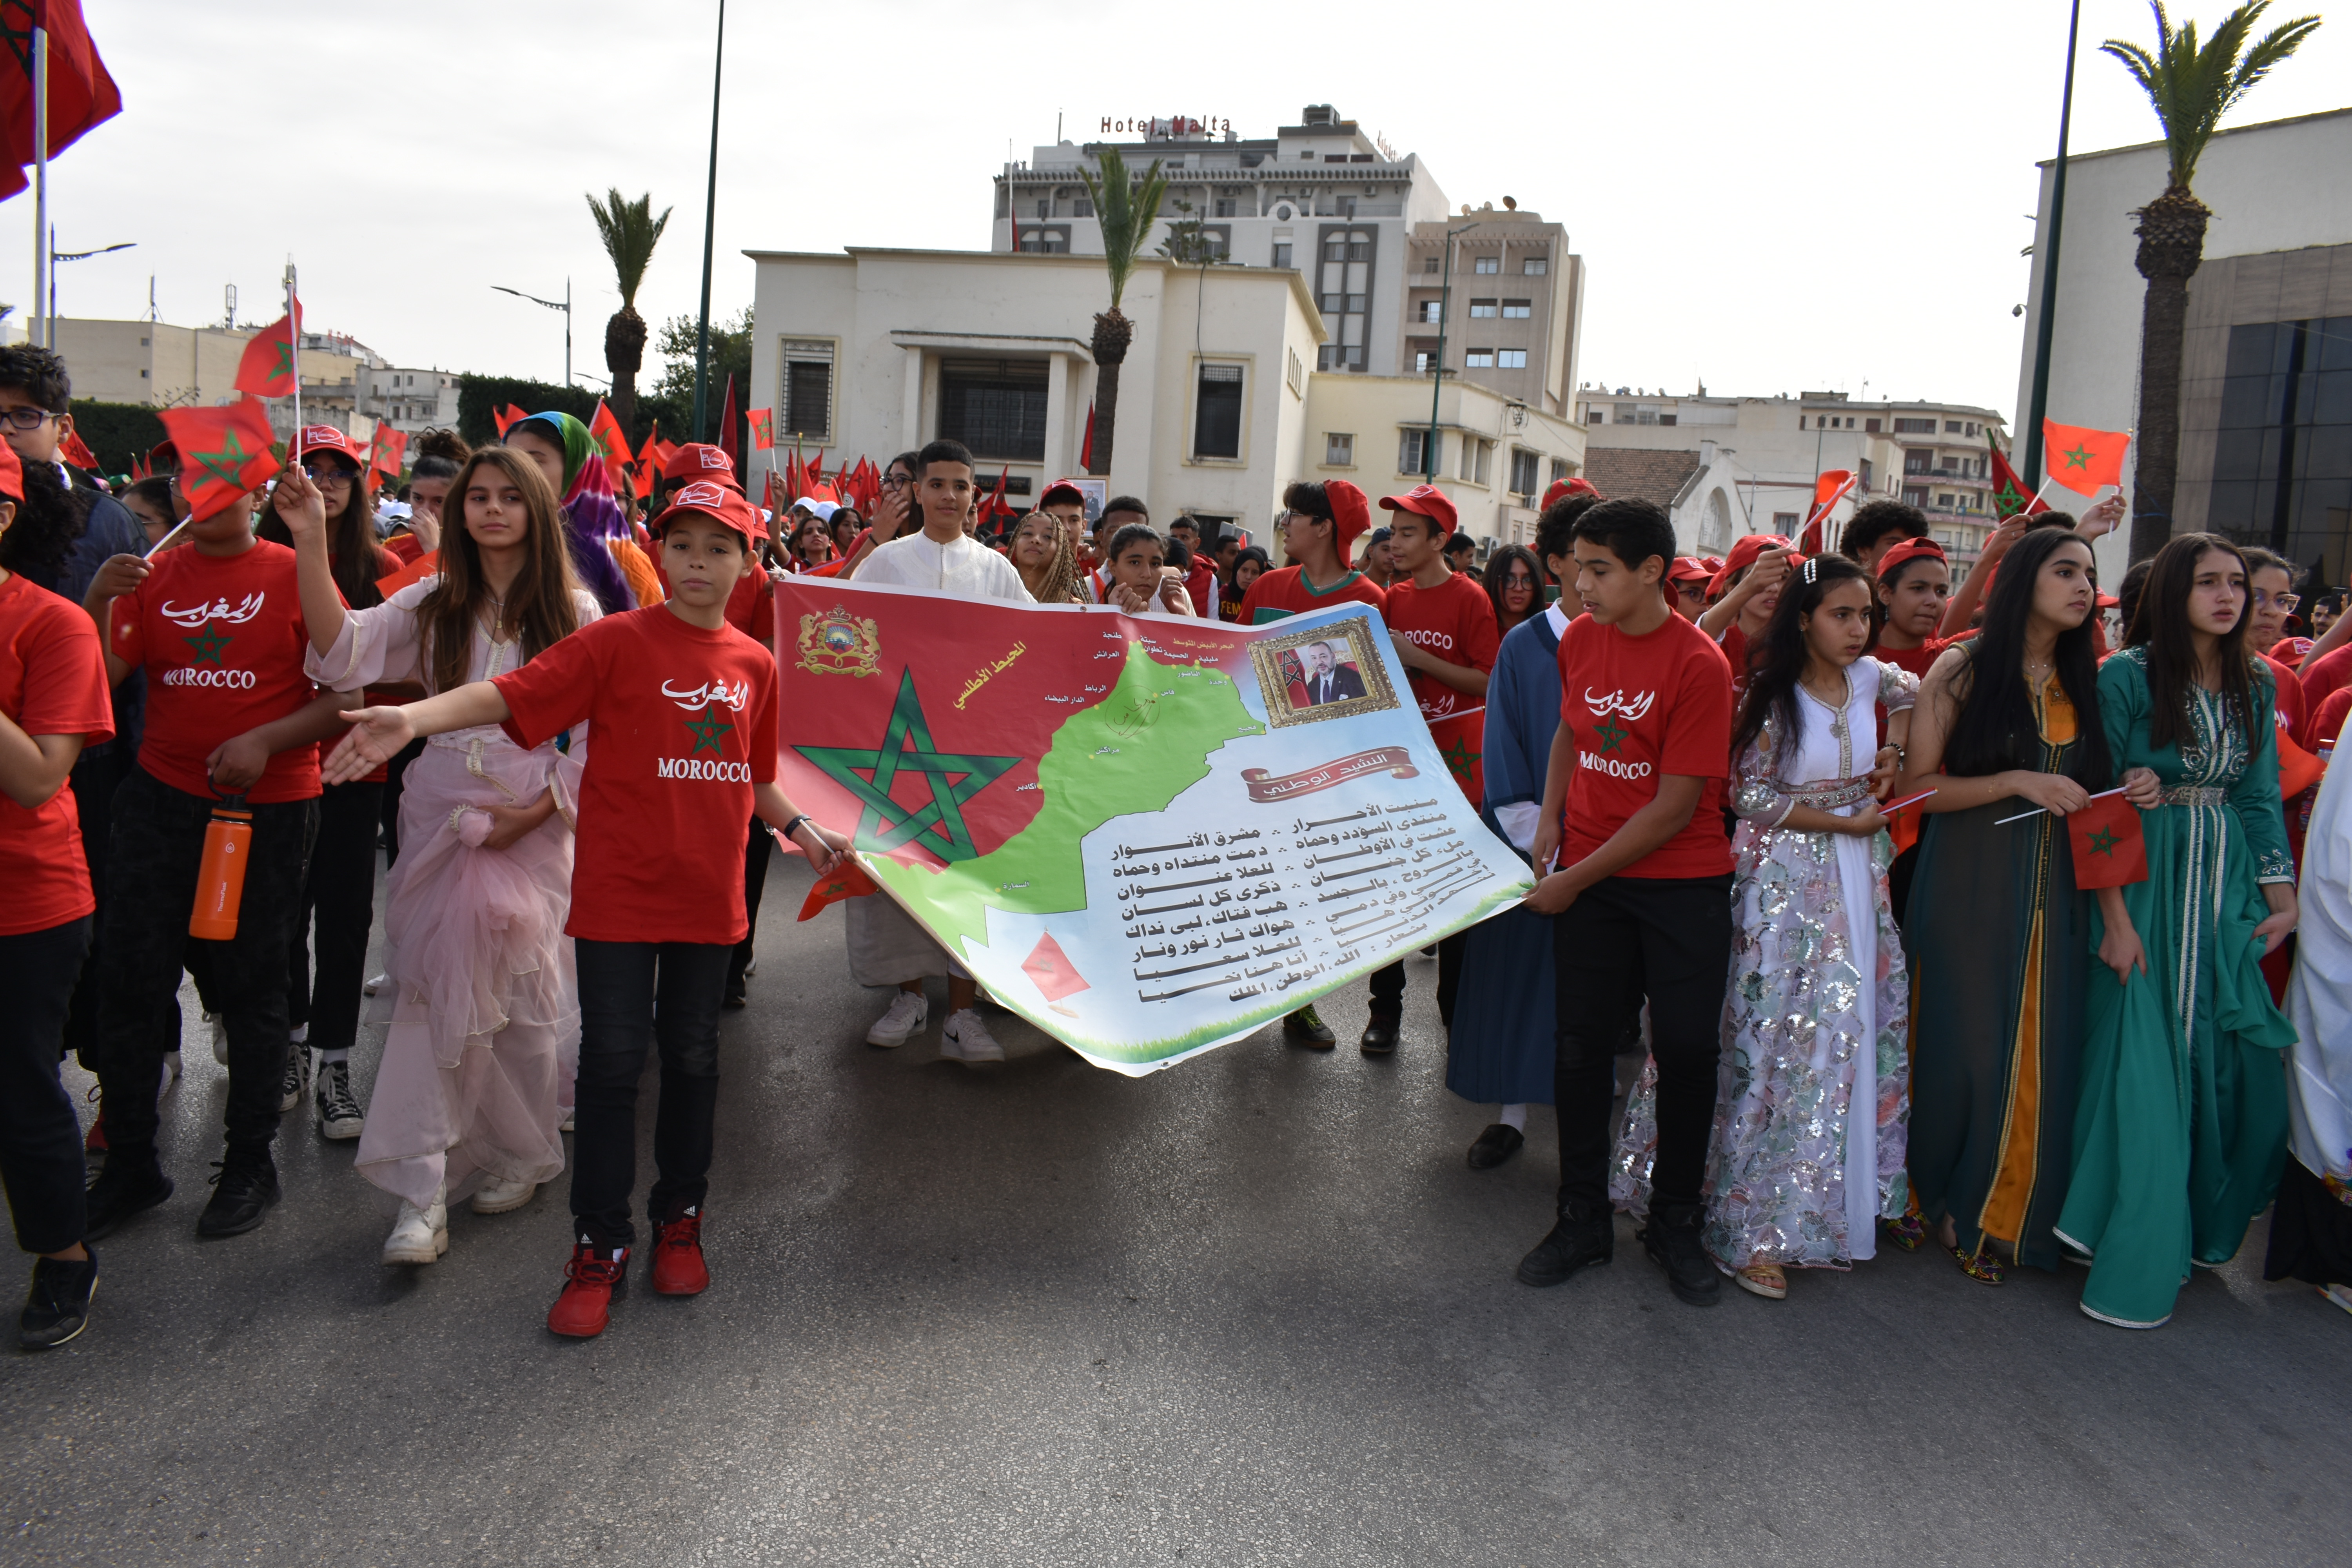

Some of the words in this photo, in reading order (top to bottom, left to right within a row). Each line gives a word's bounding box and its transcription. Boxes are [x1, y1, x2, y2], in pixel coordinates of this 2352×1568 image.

[1101, 116, 1155, 132] Hotel
[1172, 115, 1230, 132] Malta
[162, 591, 265, 627] المغرب
[1221, 601, 1241, 615] FEM
[1140, 635, 1156, 644] سبتة
[1173, 638, 1196, 648] المتوسط
[1405, 630, 1452, 650] ROCCO
[991, 640, 1027, 673] المحيط
[1093, 651, 1119, 659] العرائش
[1163, 649, 1189, 659] الحسيمة
[163, 668, 256, 689] MOROCCO
[662, 679, 748, 711] المغرب
[953, 668, 993, 710] الأطلسي
[1085, 684, 1106, 692] الرباط
[1419, 694, 1454, 717] المغ
[1585, 687, 1655, 720] المغرب
[657, 758, 751, 782] MOROCCO
[1339, 754, 1388, 774] النشيد
[1580, 751, 1651, 779] MOROCCO
[1263, 771, 1331, 795] الوطني
[1342, 820, 1393, 840] السؤدد
[1296, 833, 1339, 849] وحماه
[1400, 834, 1414, 851] في
[1436, 840, 1464, 854] ملء
[1411, 848, 1432, 862] كل
[1113, 863, 1160, 877] وحماه
[1236, 862, 1274, 879] للعلا
[1003, 881, 1029, 890] السمارة
[1236, 881, 1281, 901] ذكرى
[1209, 889, 1232, 906] كل
[1383, 889, 1407, 906] وفي
[1255, 901, 1288, 917] هب
[1125, 921, 1165, 938] نداك
[1249, 920, 1295, 938] هواك
[1180, 935, 1209, 955] نور
[1286, 949, 1308, 965] أنا
[1229, 982, 1266, 1001] الملك
